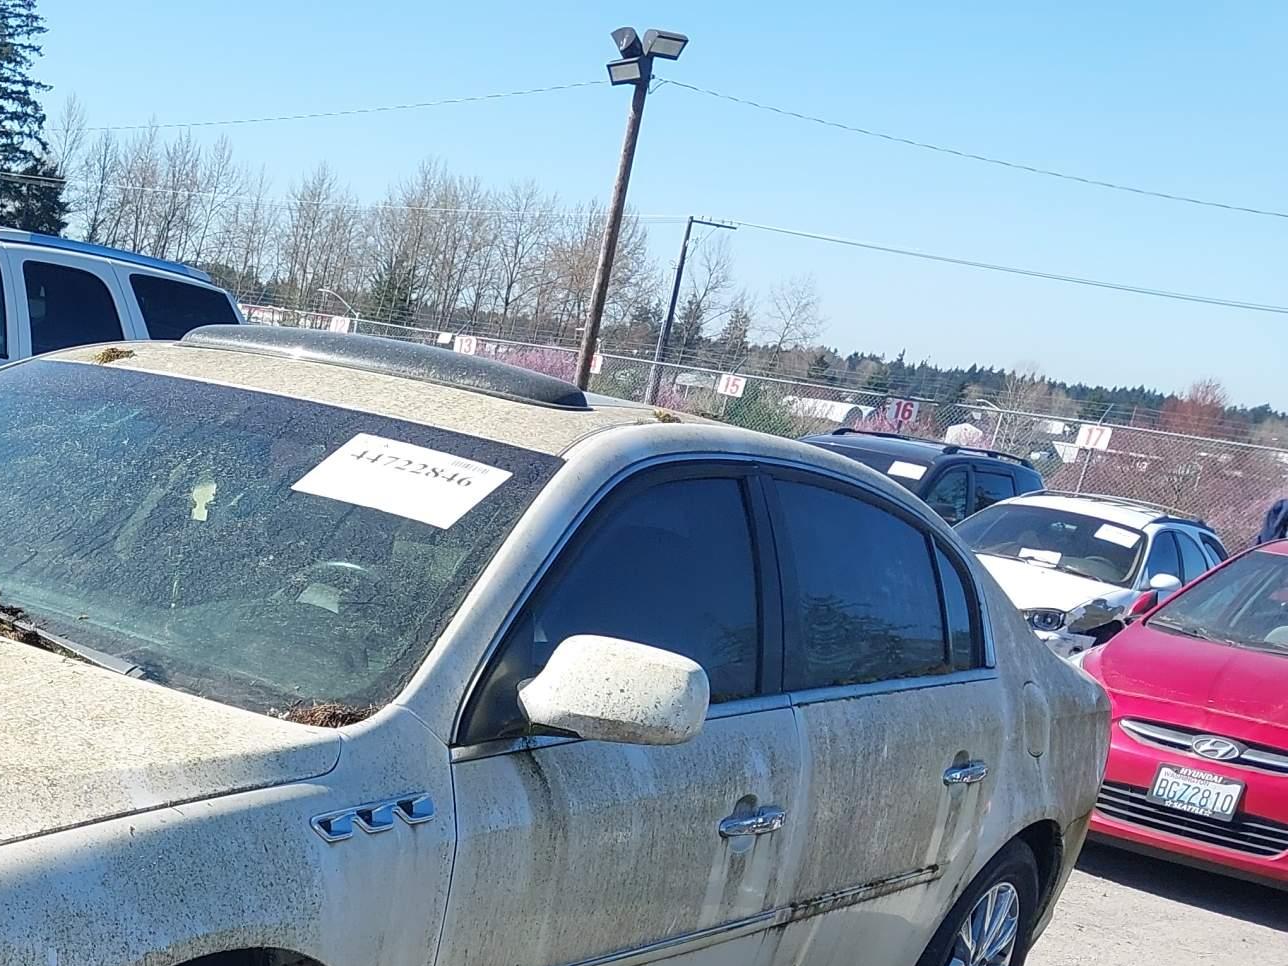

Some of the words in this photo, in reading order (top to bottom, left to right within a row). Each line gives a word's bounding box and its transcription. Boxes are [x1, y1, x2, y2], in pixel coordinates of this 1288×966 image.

[459, 337, 473, 354] 13
[722, 376, 741, 395] 15
[894, 401, 913, 421] 16
[1084, 427, 1106, 446] 17
[350, 449, 473, 488] 44722846
[1179, 767, 1224, 784] HYUNDAI
[1155, 778, 1234, 813] BGZ2810
[1171, 801, 1206, 816] SEATTLE
